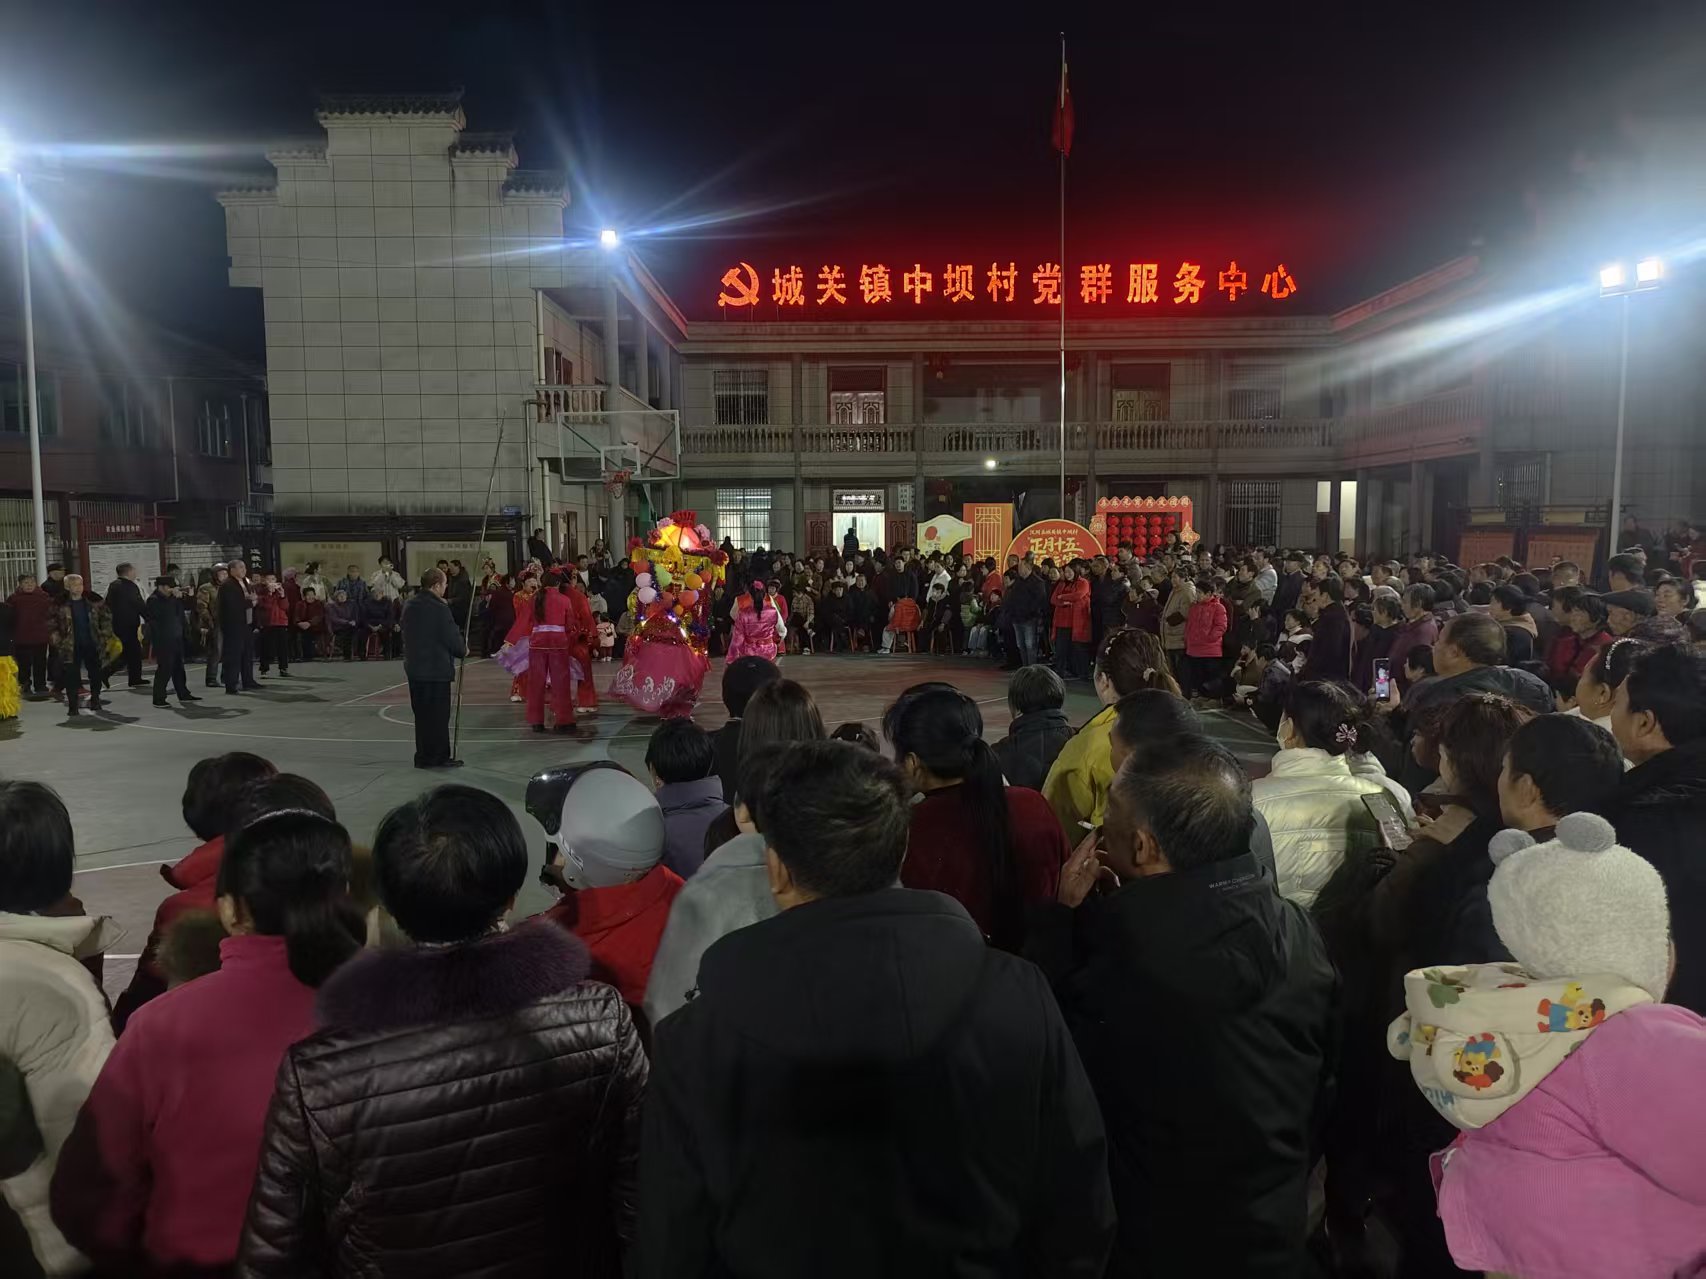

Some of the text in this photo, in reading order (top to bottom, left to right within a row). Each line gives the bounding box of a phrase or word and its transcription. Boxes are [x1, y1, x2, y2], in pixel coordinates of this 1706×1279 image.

[771, 261, 1298, 305] 城关镇中坝村党群服务中心
[1029, 536, 1085, 554] 正月十五
